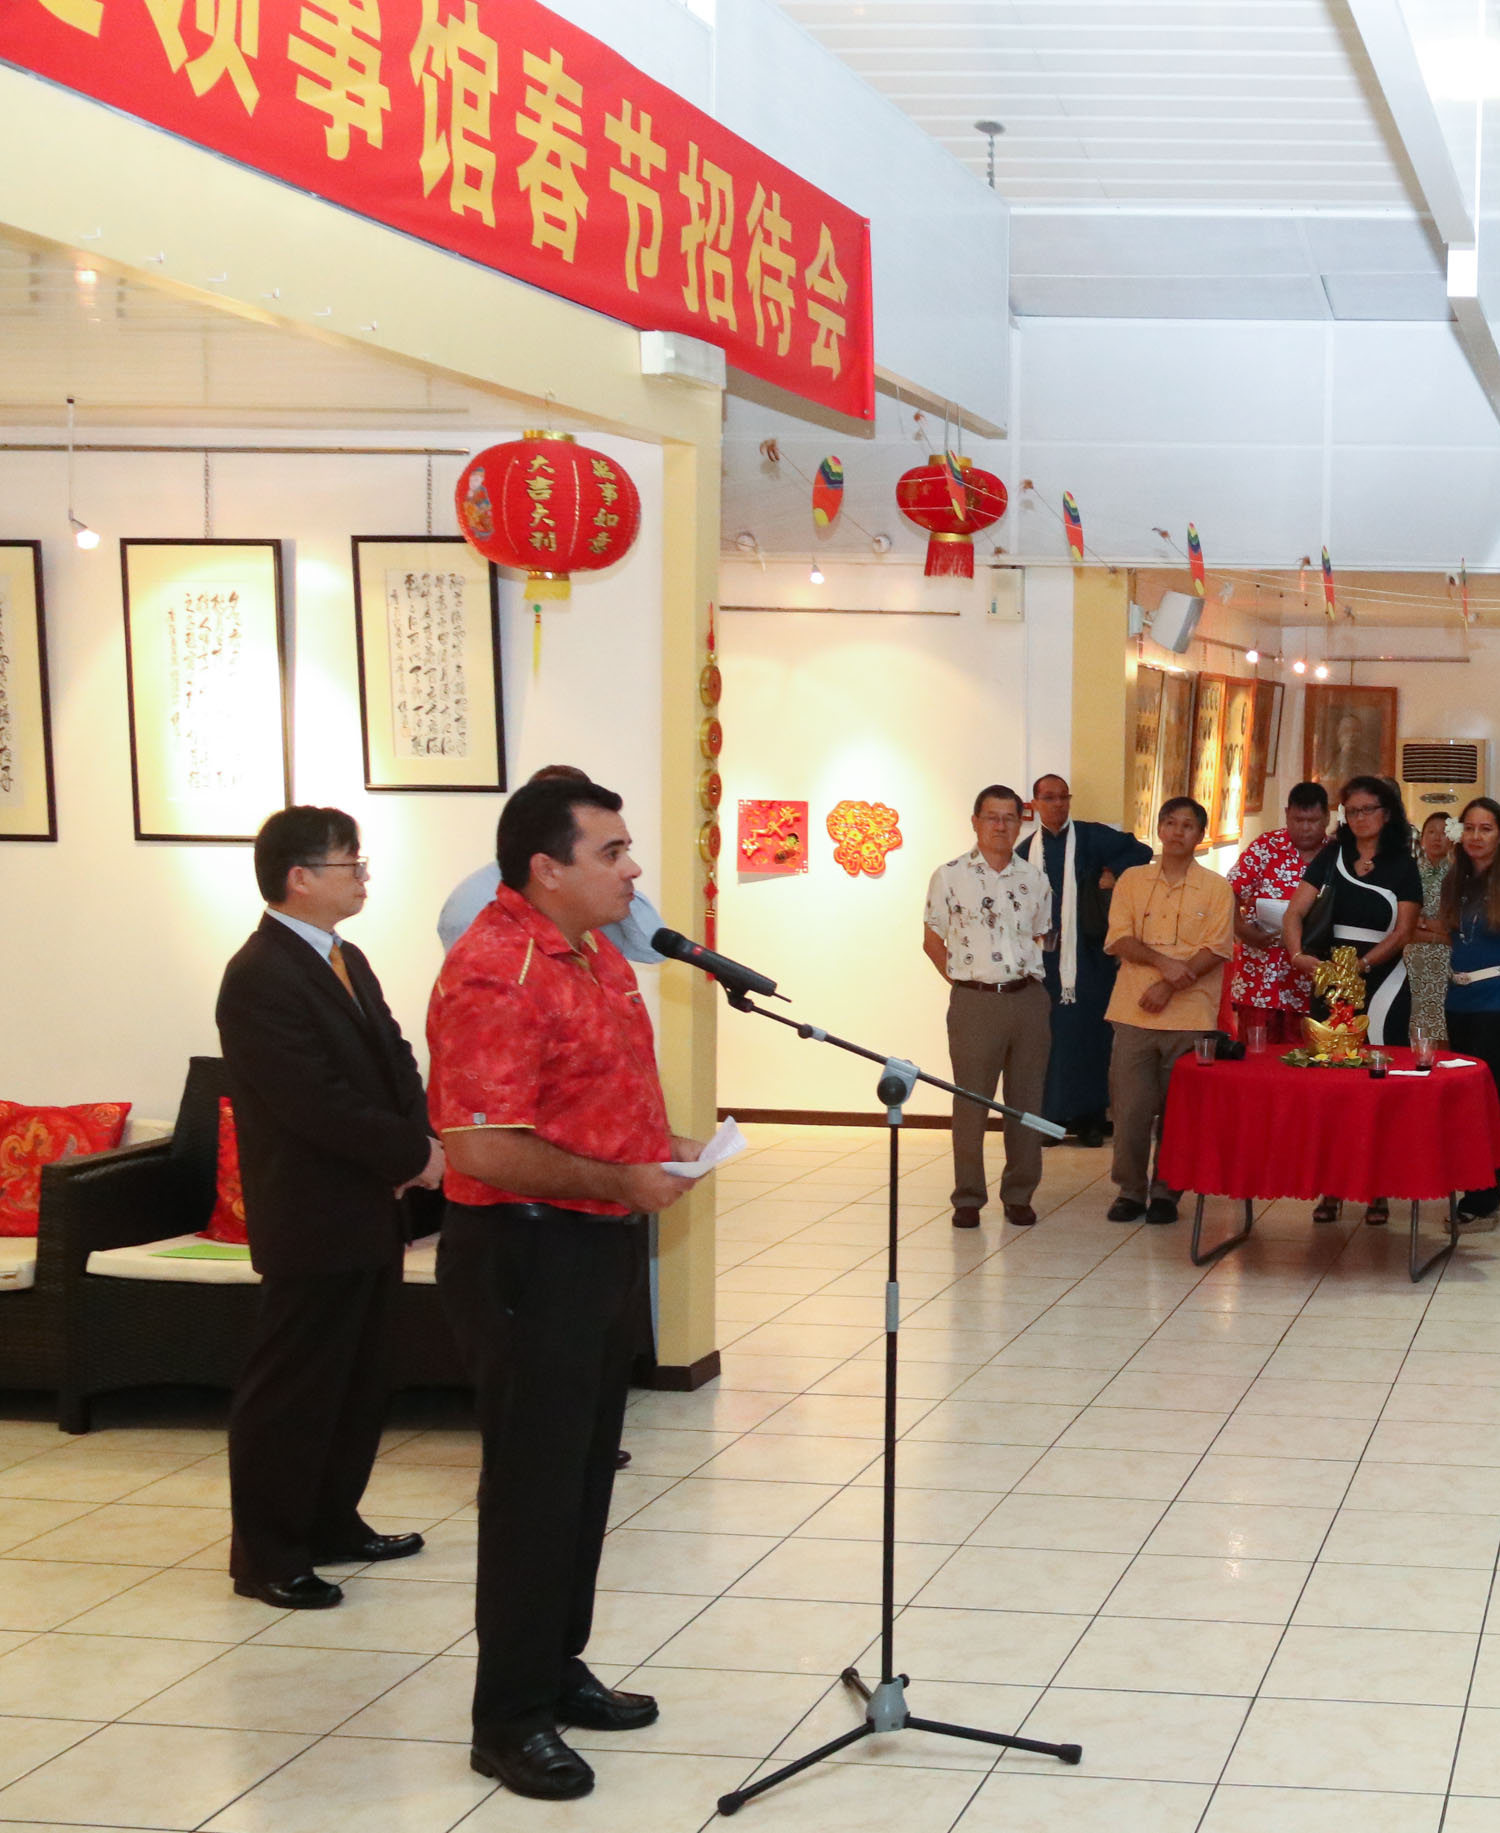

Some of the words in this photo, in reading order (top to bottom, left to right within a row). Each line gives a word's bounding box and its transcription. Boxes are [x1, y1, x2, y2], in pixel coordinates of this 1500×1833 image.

[38, 0, 849, 381] 事馆春节招待会
[524, 454, 556, 552] 大吉大利
